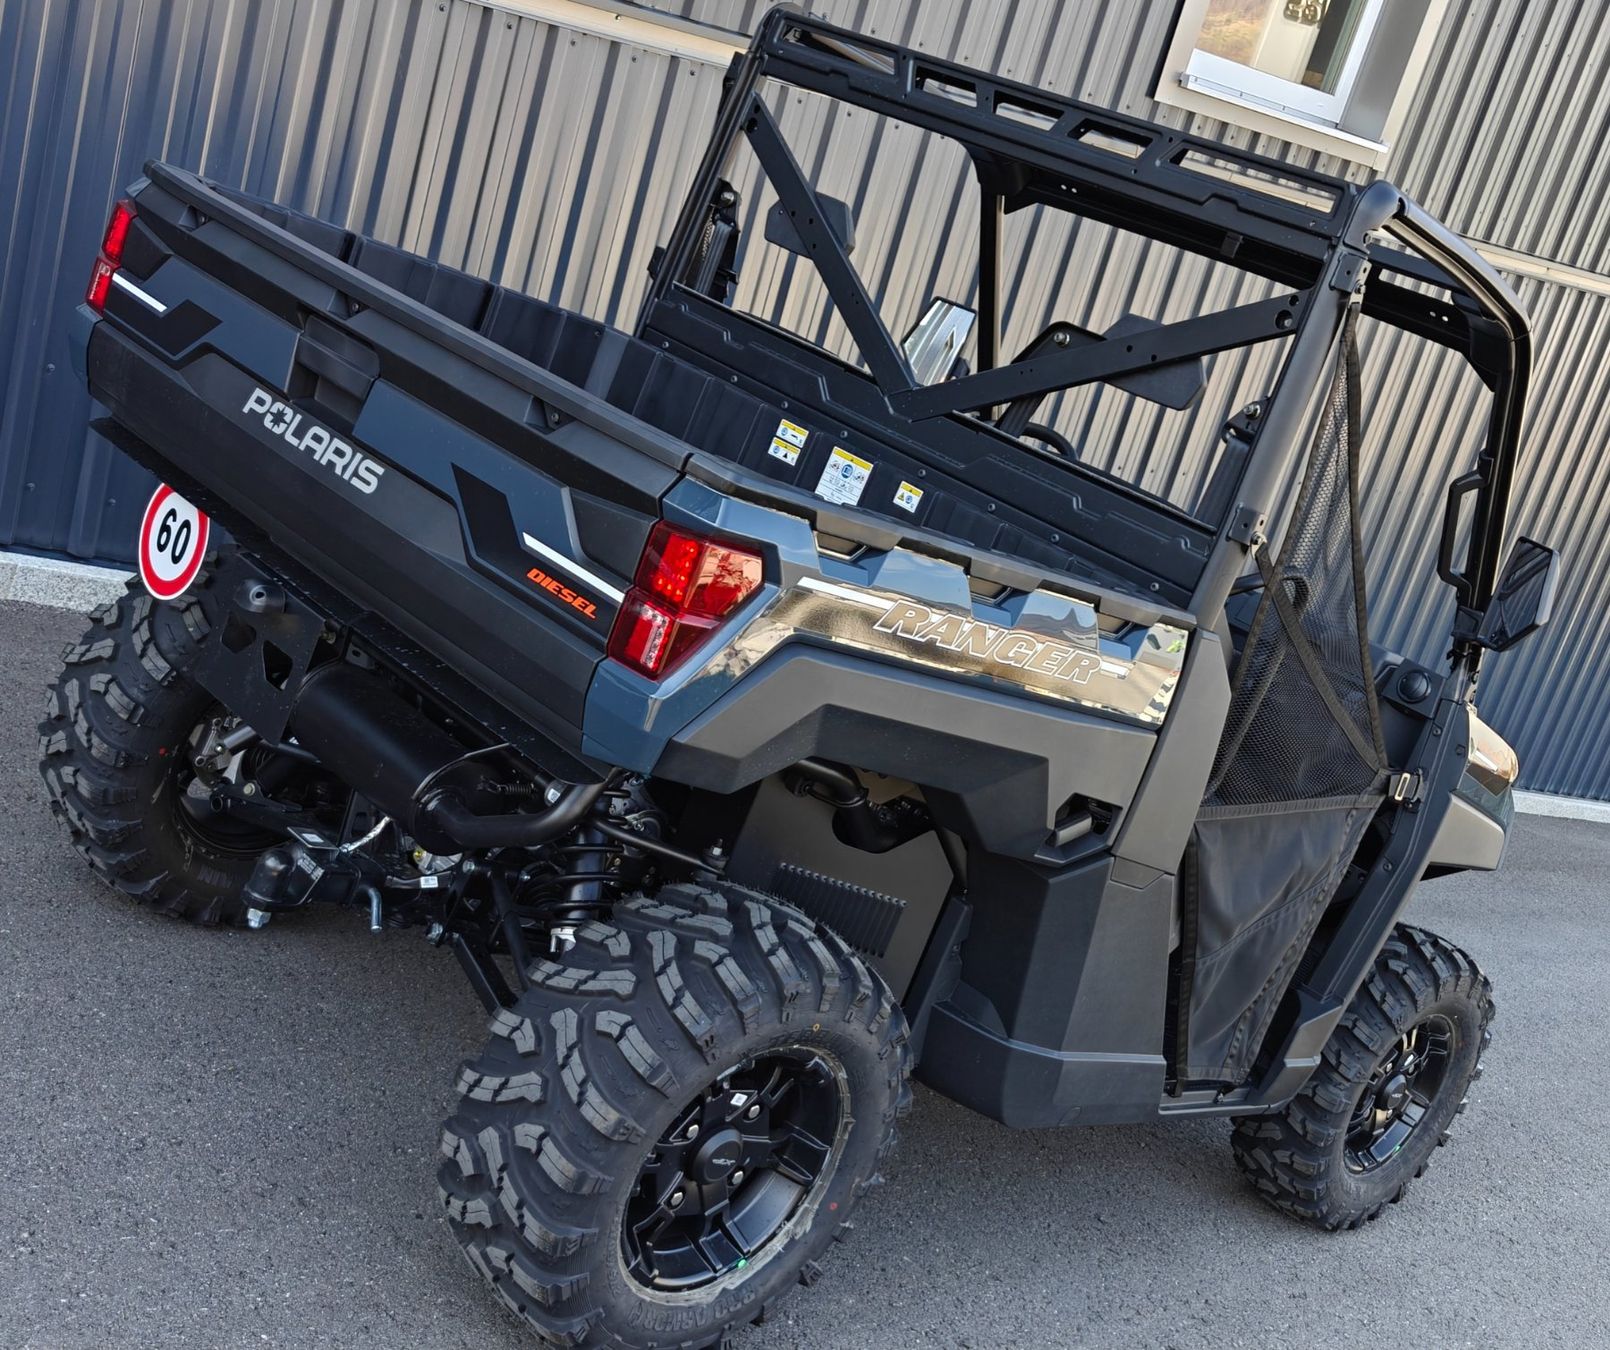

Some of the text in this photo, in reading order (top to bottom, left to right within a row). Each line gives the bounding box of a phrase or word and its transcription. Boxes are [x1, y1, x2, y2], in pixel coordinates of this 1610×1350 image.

[242, 387, 385, 494] POLARIS
[156, 507, 192, 565] 60
[526, 567, 598, 620] DIESEL
[873, 600, 1102, 684] RANGER
